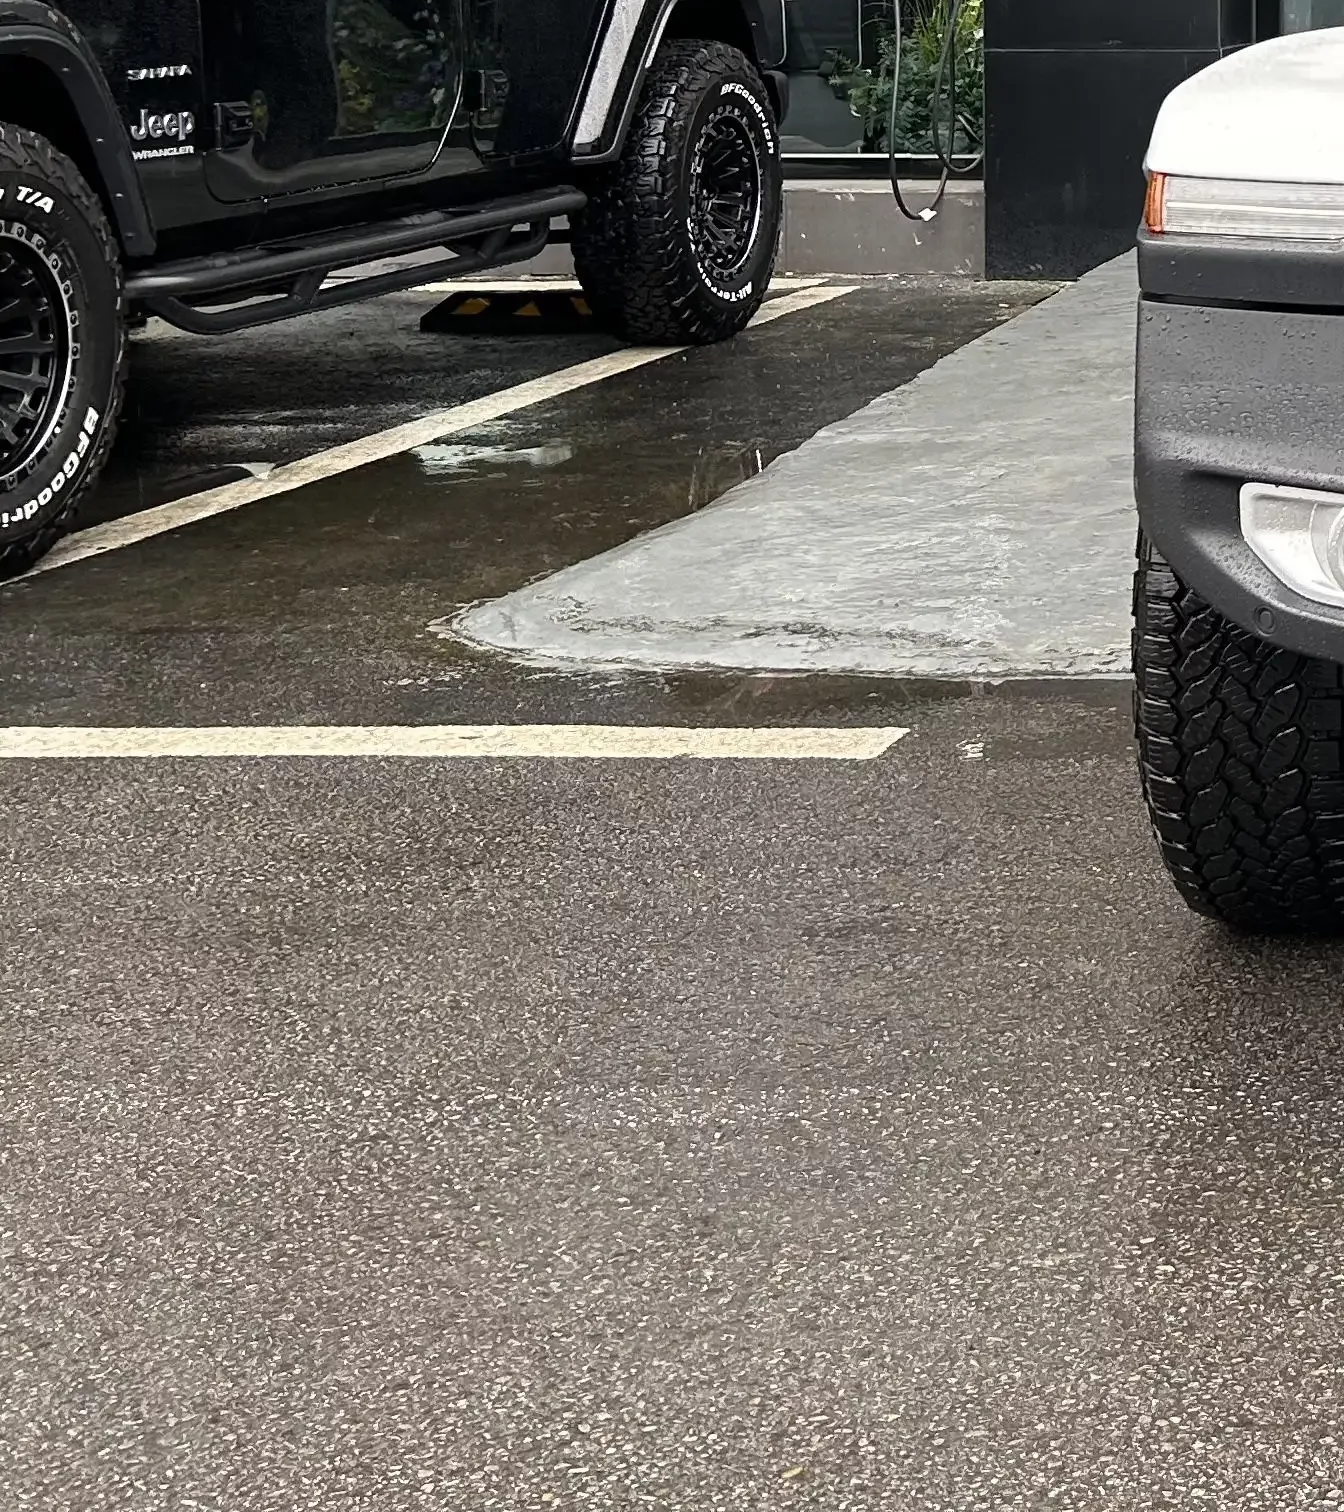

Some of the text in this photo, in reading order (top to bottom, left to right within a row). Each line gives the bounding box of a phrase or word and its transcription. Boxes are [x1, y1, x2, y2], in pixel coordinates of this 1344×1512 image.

[130, 108, 196, 142] Jeep
[131, 145, 195, 161] WRANGLER
[16, 185, 55, 214] T/A
[1, 406, 100, 528] BFGoodri
